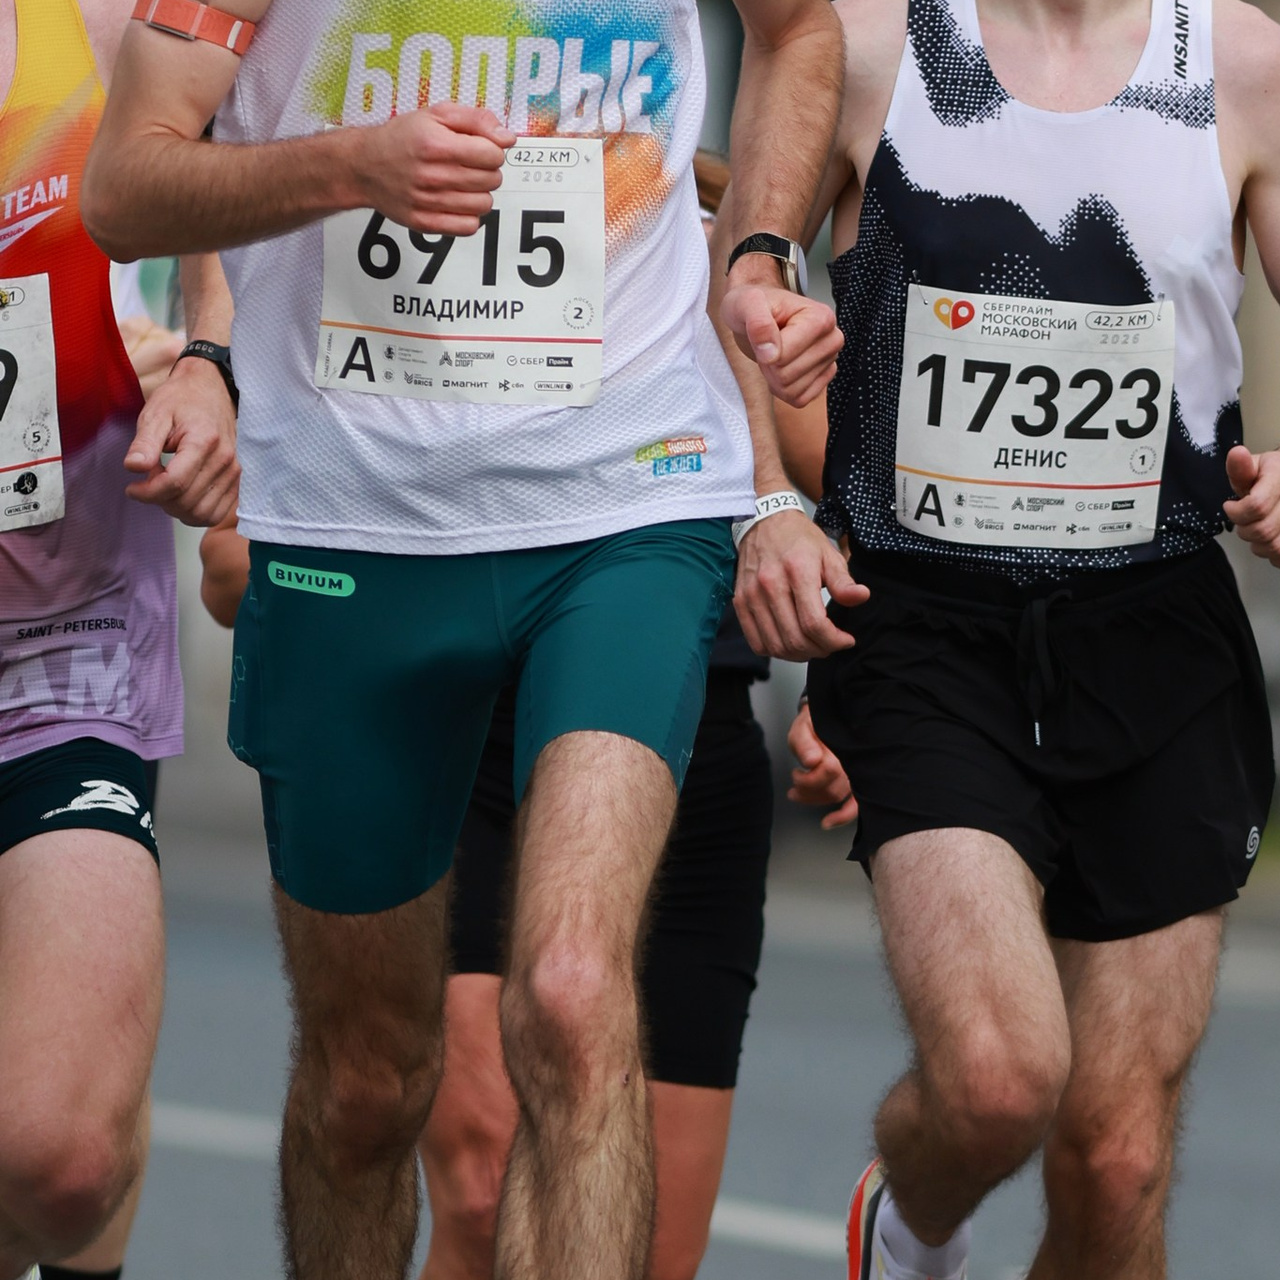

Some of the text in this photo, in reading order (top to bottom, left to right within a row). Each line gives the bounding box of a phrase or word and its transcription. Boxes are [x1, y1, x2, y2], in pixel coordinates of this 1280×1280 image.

[514, 150, 545, 163] 42,2
[521, 171, 564, 183] 2026
[2, 174, 69, 220] TEAM
[357, 208, 566, 288] 6915
[393, 294, 524, 322] ВЛАДИМИР
[573, 307, 583, 319] 2
[983, 301, 1053, 316] СБЕРПРАЙМ
[981, 312, 1077, 331] МОСКОВСКИЙ
[1093, 316, 1125, 328] 42,2
[980, 325, 1051, 341] МАРАФОН
[1100, 333, 1141, 345] 2026
[338, 336, 376, 383] A
[455, 351, 495, 360] МОСКОВСКИЙ
[519, 357, 545, 365] СБЕР
[451, 380, 489, 389] магнит
[916, 353, 1162, 440] 17323
[32, 431, 42, 443] 5
[993, 447, 1068, 470] ДЕНИС
[1138, 455, 1147, 466] 1
[914, 483, 946, 528] A
[1087, 503, 1110, 511] СБЕР
[1021, 524, 1057, 532] магнит
[275, 568, 343, 591] BIVIUM
